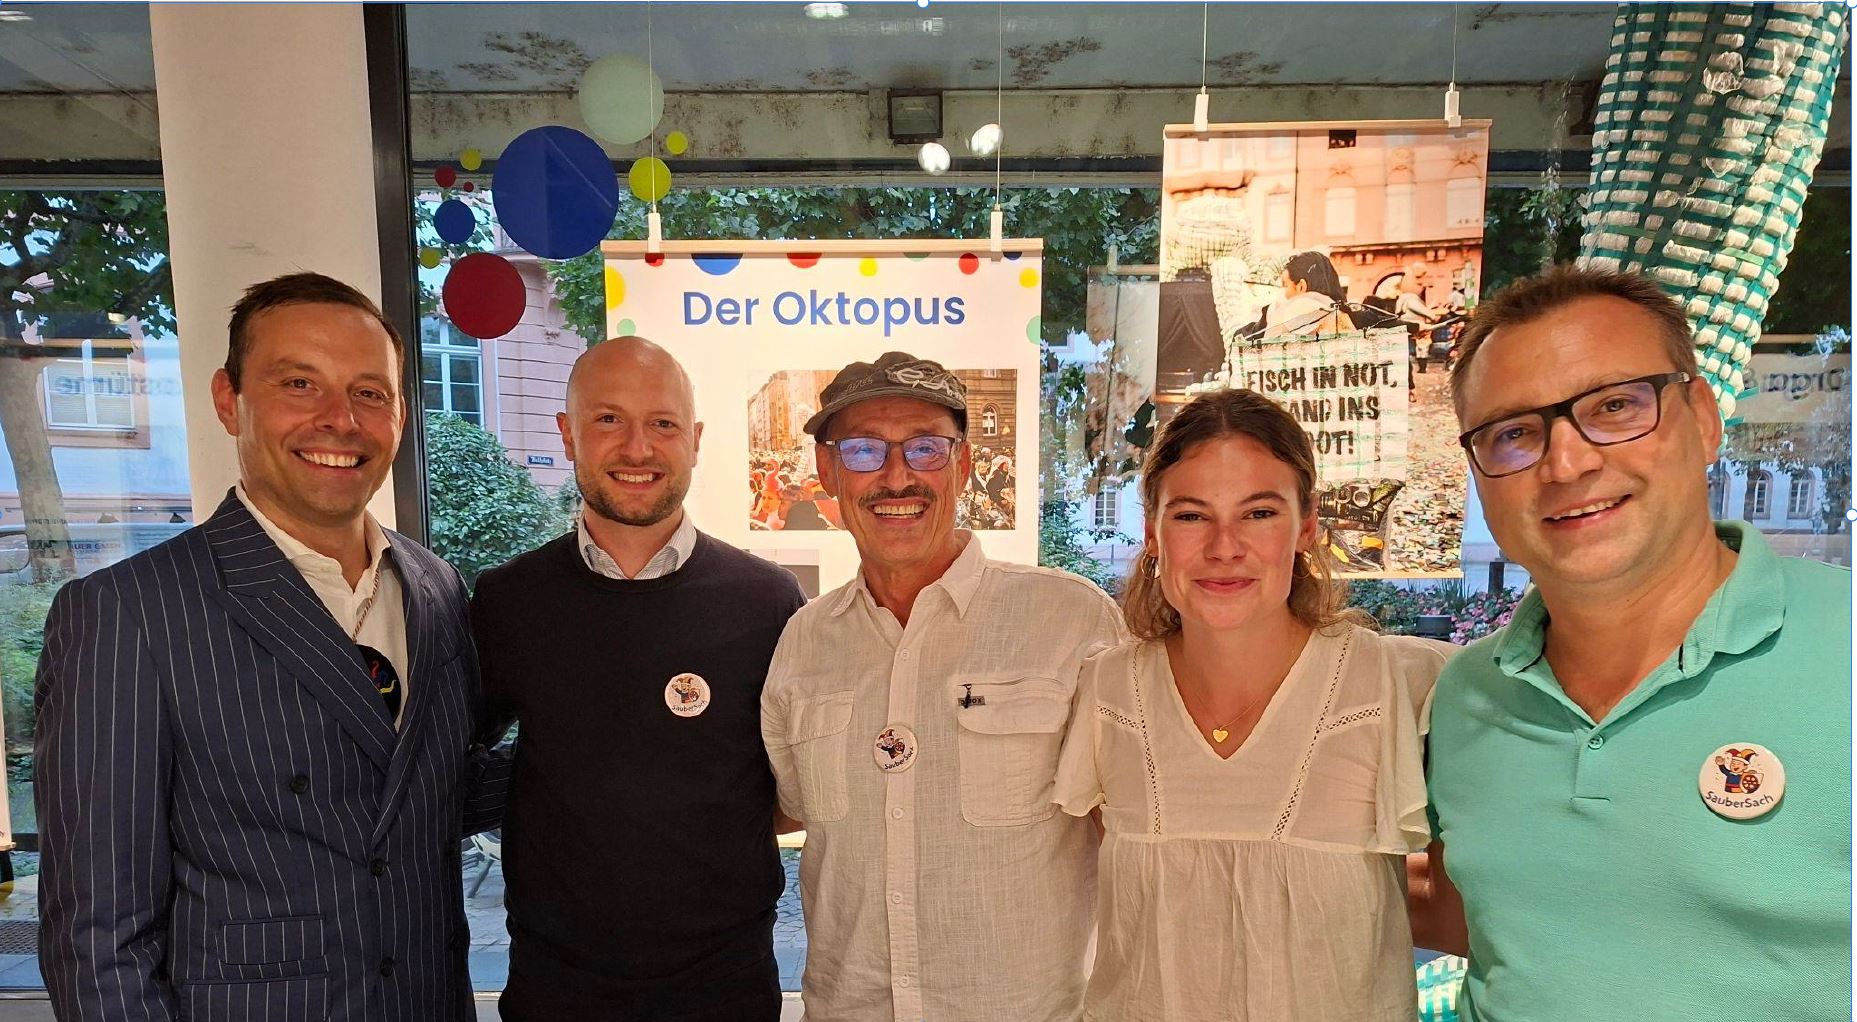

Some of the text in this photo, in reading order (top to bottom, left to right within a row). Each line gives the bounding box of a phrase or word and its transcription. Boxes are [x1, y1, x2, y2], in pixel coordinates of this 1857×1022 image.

[683, 289, 966, 337] Der Oktopus
[1246, 360, 1398, 393] FISCH IN NOT,
[1338, 395, 1381, 422] INS
[1705, 790, 1775, 809] SauberSach
